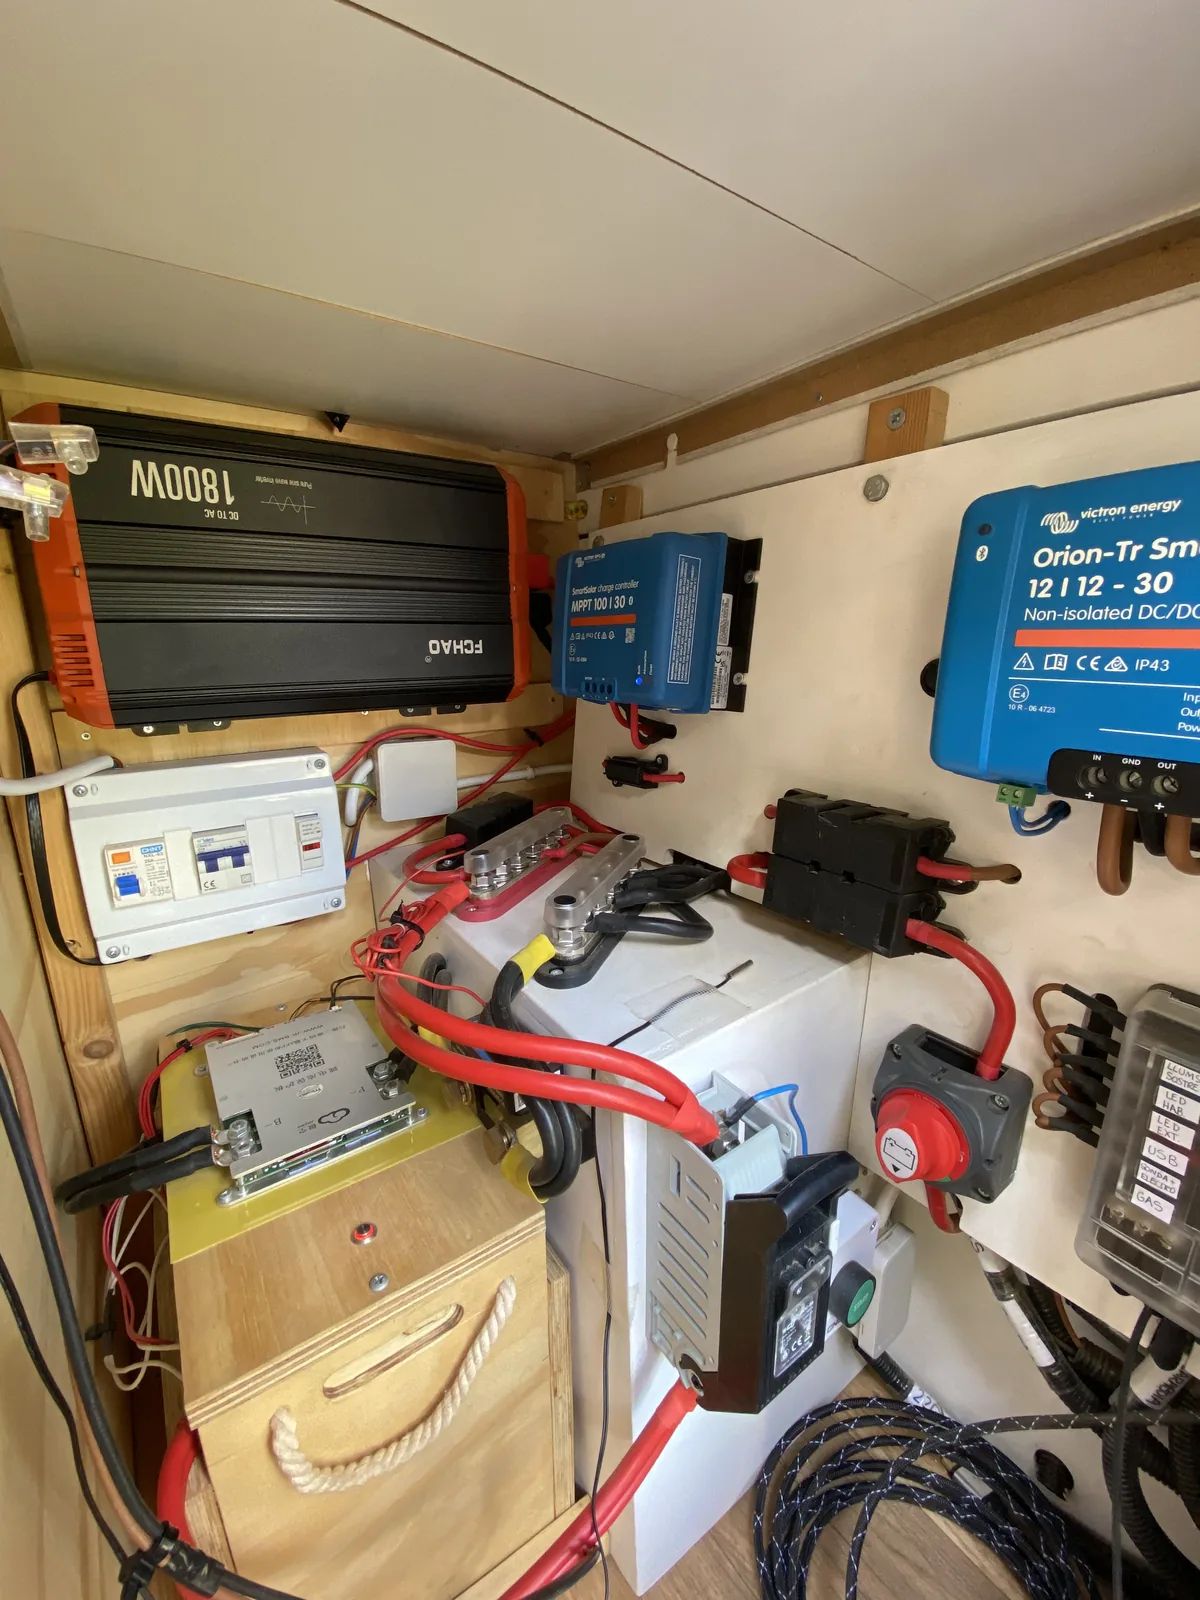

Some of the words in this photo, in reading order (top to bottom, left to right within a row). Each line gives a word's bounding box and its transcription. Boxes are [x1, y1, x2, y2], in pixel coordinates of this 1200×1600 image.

[131, 459, 235, 505] 1800W
[255, 475, 274, 484] inverter
[300, 481, 312, 489] Pure
[204, 508, 215, 519] AC
[216, 510, 227, 520] TO
[228, 511, 239, 521] DC
[1080, 505, 1126, 520] victron
[1130, 499, 1182, 514] energy
[1033, 540, 1144, 568] Orion-Tr
[572, 585, 598, 596] SmartSolar
[597, 583, 614, 593] charge
[614, 579, 640, 591] controller
[1029, 577, 1054, 599] 12
[1077, 574, 1105, 597] 12
[1133, 571, 1174, 595] 30
[571, 598, 592, 613] MPPT
[594, 596, 607, 611] 100
[614, 595, 626, 609] 30
[1023, 603, 1134, 622] Non-isolated
[428, 639, 483, 655] FCHAO
[1135, 658, 1170, 672] IP43
[1121, 757, 1141, 766] GND
[1157, 762, 1177, 770] OUT
[1167, 1062, 1200, 1083] LLUMS
[1165, 1071, 1199, 1092] SOSTRE
[1165, 1091, 1187, 1106] LED
[1157, 1115, 1180, 1132] LED
[1147, 1145, 1178, 1167] USB
[1136, 1191, 1163, 1212] GAS
